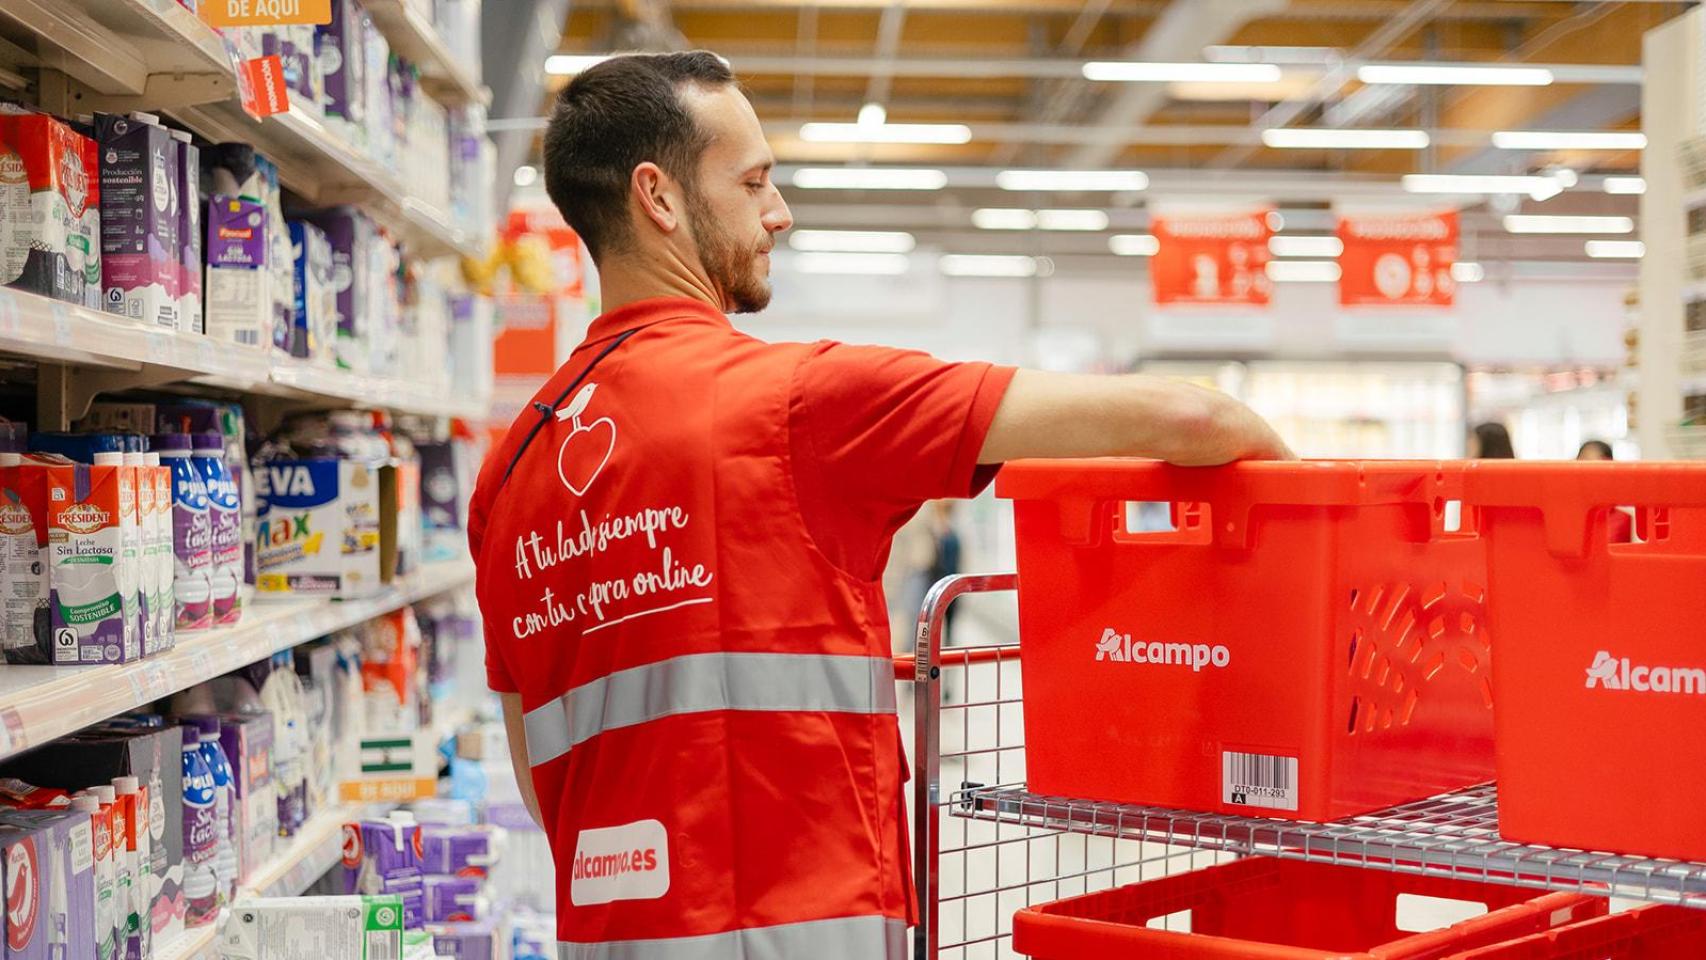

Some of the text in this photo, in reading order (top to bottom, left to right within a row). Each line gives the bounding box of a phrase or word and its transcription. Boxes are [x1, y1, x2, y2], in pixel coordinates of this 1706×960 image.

[227, 0, 250, 17] DE
[102, 175, 143, 184] sostenible
[255, 465, 315, 496] EVA
[57, 546, 113, 555] Sin Lactosa
[515, 535, 532, 579] A
[525, 530, 557, 570] tu
[597, 506, 689, 552] siempre
[513, 546, 713, 639] con tu cpra online
[1095, 628, 1230, 672] Alcampo
[1585, 650, 1706, 695] Alcam
[1235, 793, 1243, 803] A
